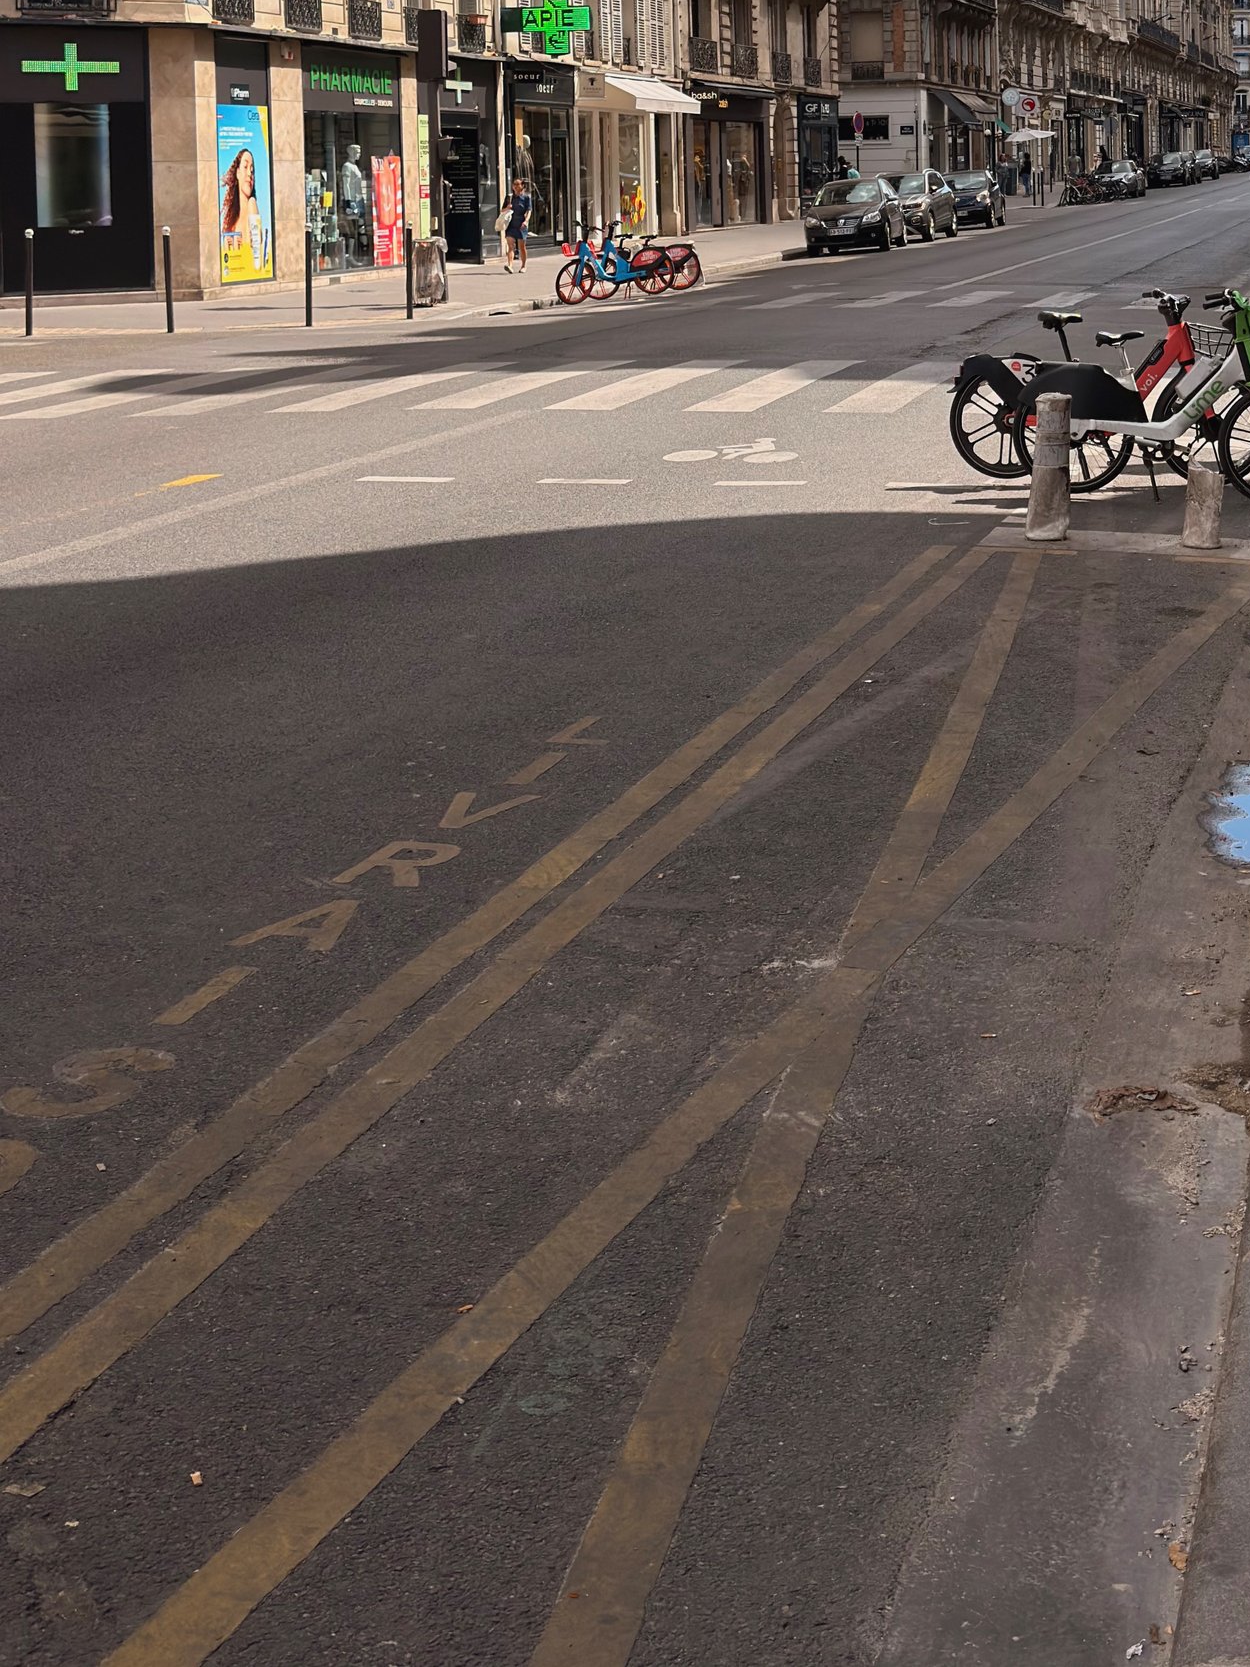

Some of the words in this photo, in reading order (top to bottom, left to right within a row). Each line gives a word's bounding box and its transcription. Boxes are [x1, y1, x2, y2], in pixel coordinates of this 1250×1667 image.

[523, 9, 574, 28] APIE
[310, 63, 393, 95] PHARMACIE
[513, 71, 541, 80] soeur
[691, 91, 718, 100] ba&sh
